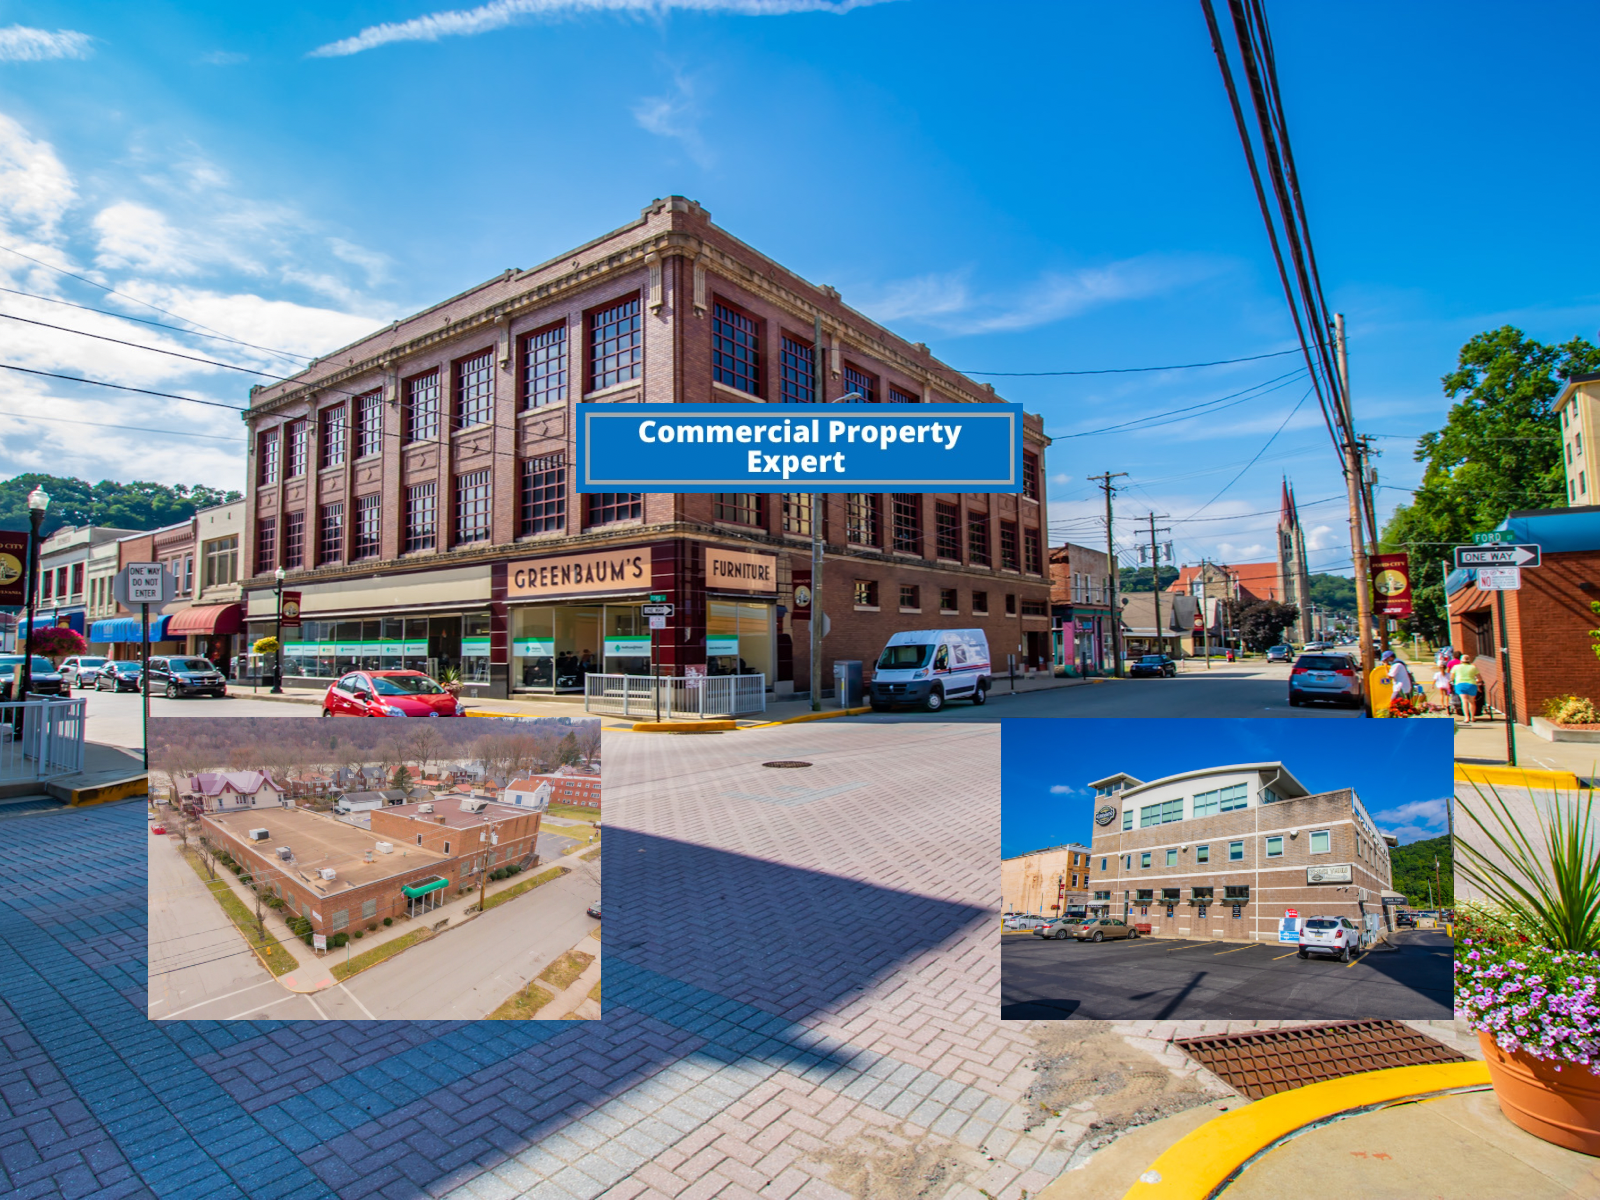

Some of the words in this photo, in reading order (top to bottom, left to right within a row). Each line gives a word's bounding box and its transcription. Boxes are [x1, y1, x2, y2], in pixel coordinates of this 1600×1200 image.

[1475, 532, 1501, 542] FORD
[1464, 552, 1487, 562] ONE
[1490, 552, 1513, 561] WAY
[130, 567, 144, 575] ONE
[147, 567, 160, 575] WAY
[514, 556, 643, 589] GREENBAUM'S
[713, 559, 770, 581] FURNITURE
[132, 578, 143, 586] DO
[145, 578, 158, 586] NOT
[1481, 576, 1491, 587] NO
[135, 589, 156, 597] ENTER
